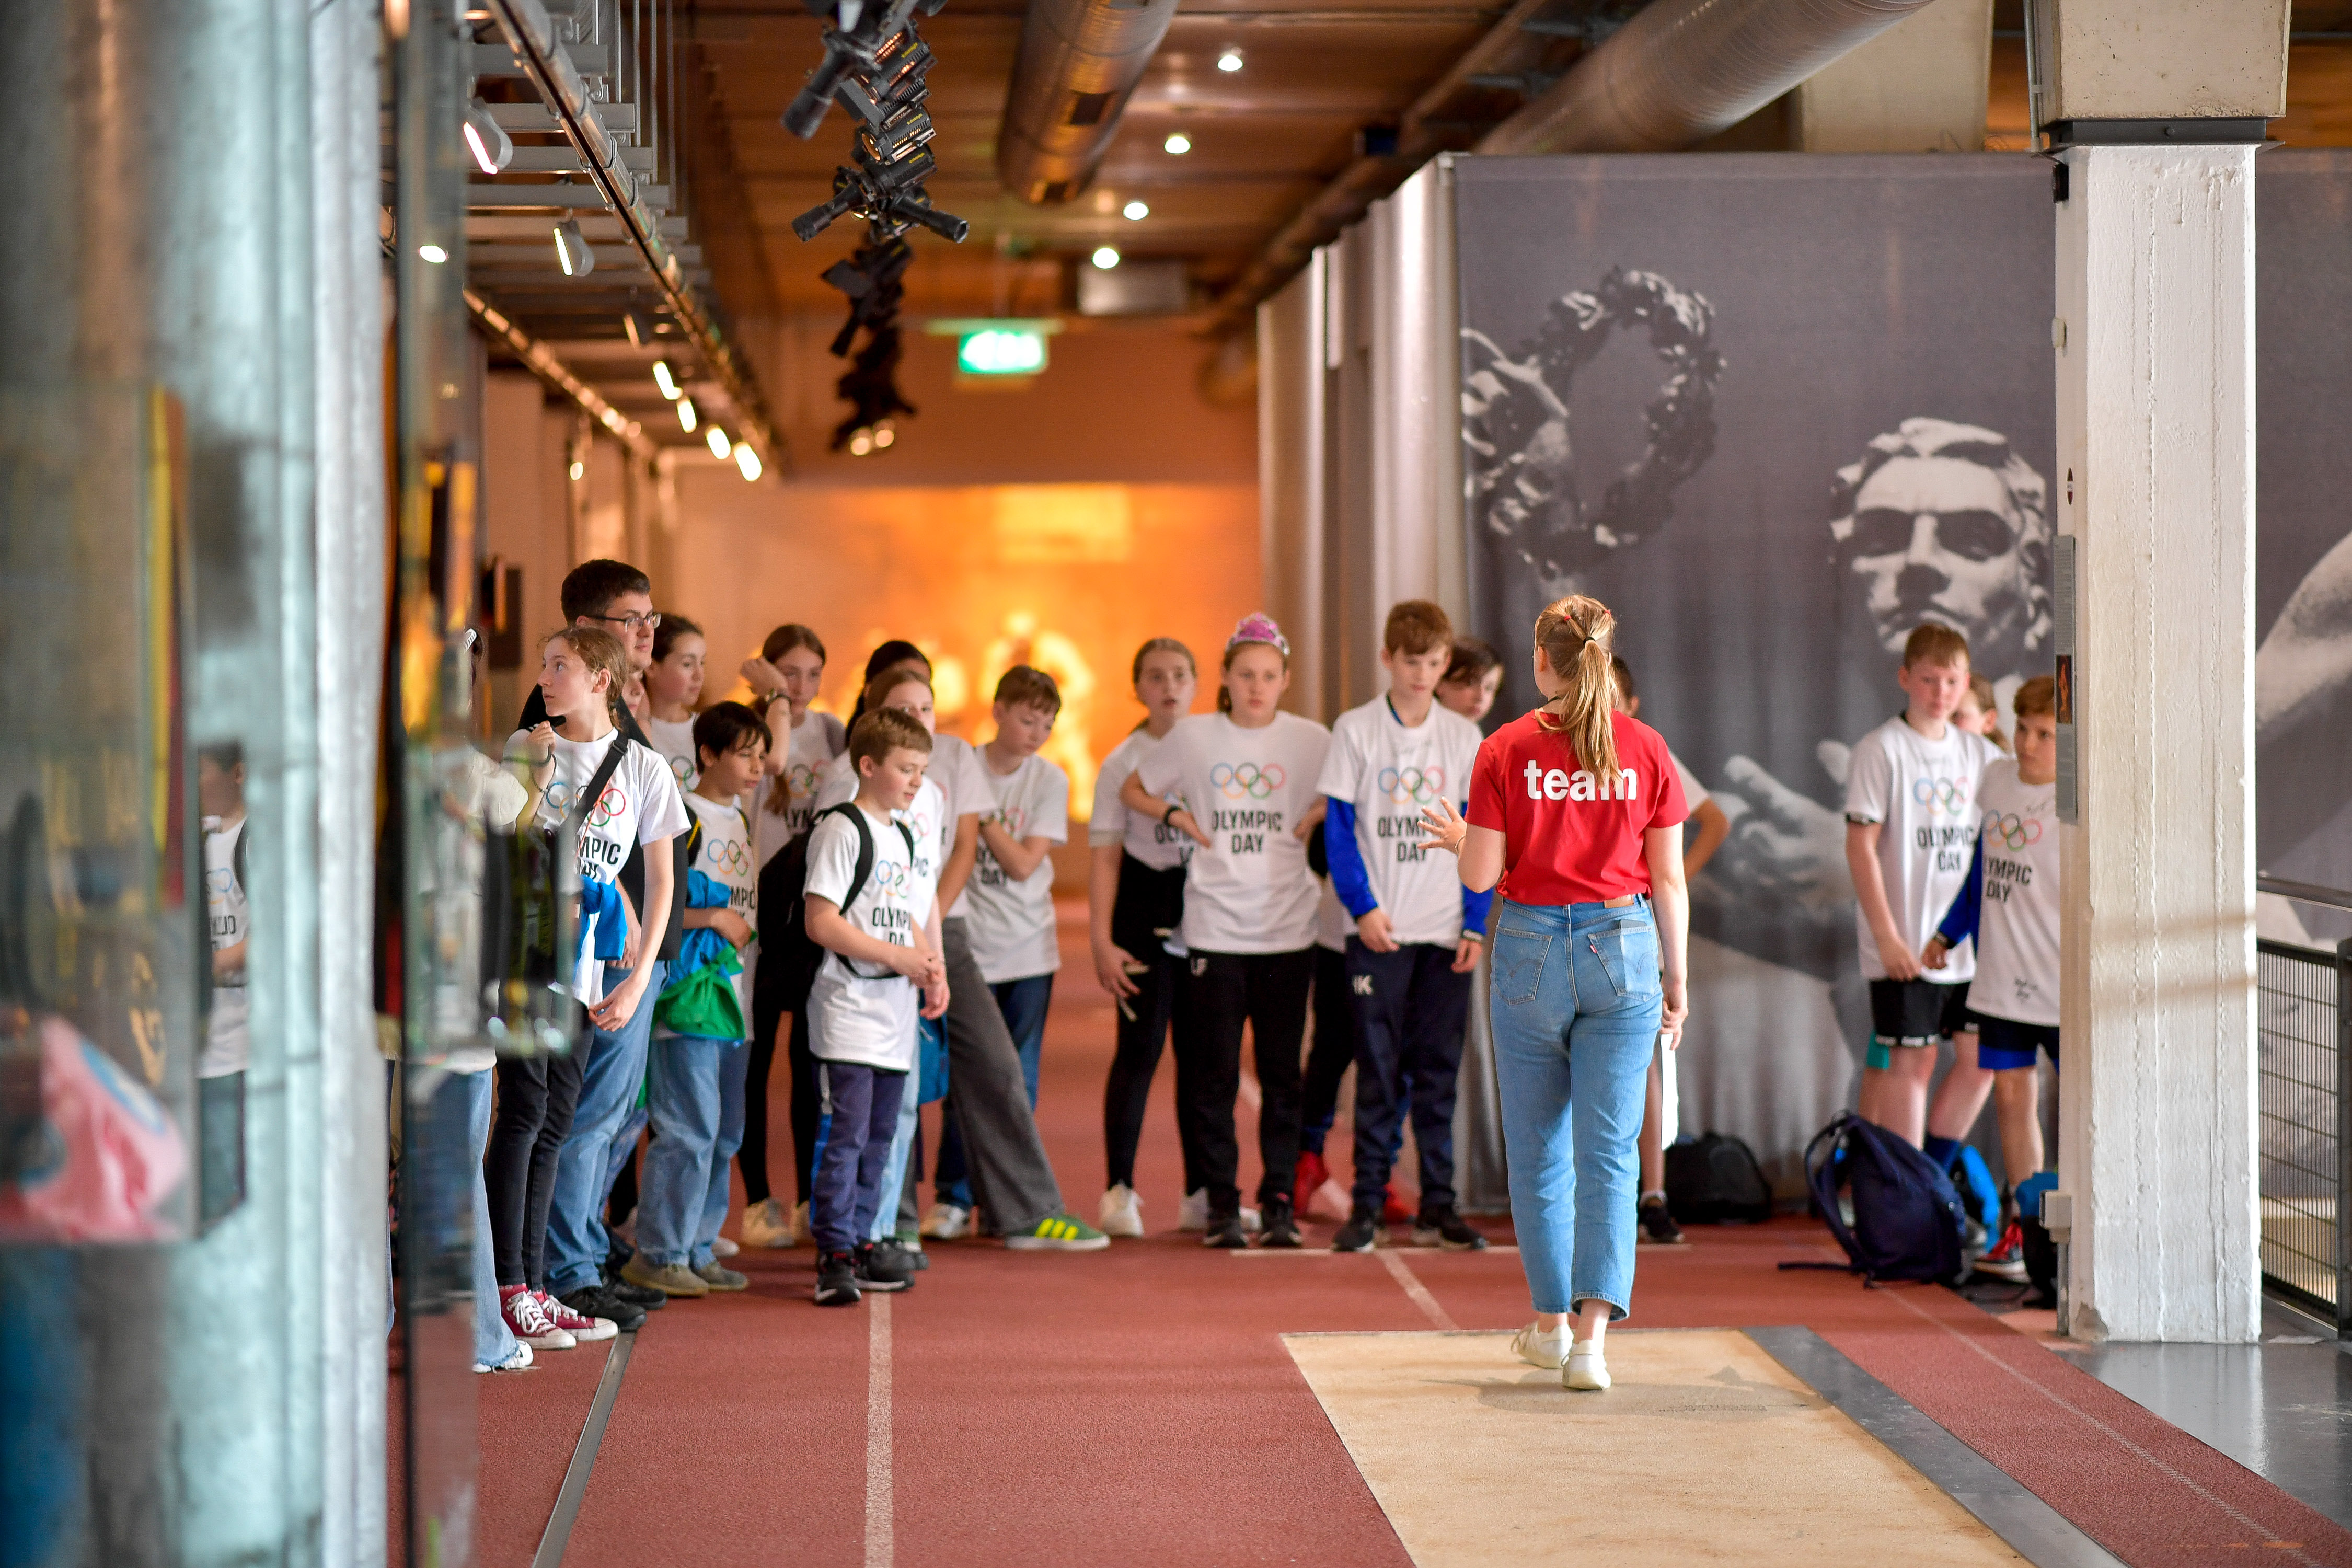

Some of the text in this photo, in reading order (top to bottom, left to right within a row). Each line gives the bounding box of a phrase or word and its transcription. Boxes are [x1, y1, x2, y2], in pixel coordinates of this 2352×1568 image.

[1524, 760, 1637, 801] team
[1212, 810, 1282, 832] OLYMPIC
[1232, 833, 1264, 854] DAY
[1986, 879, 2011, 902] DAY
